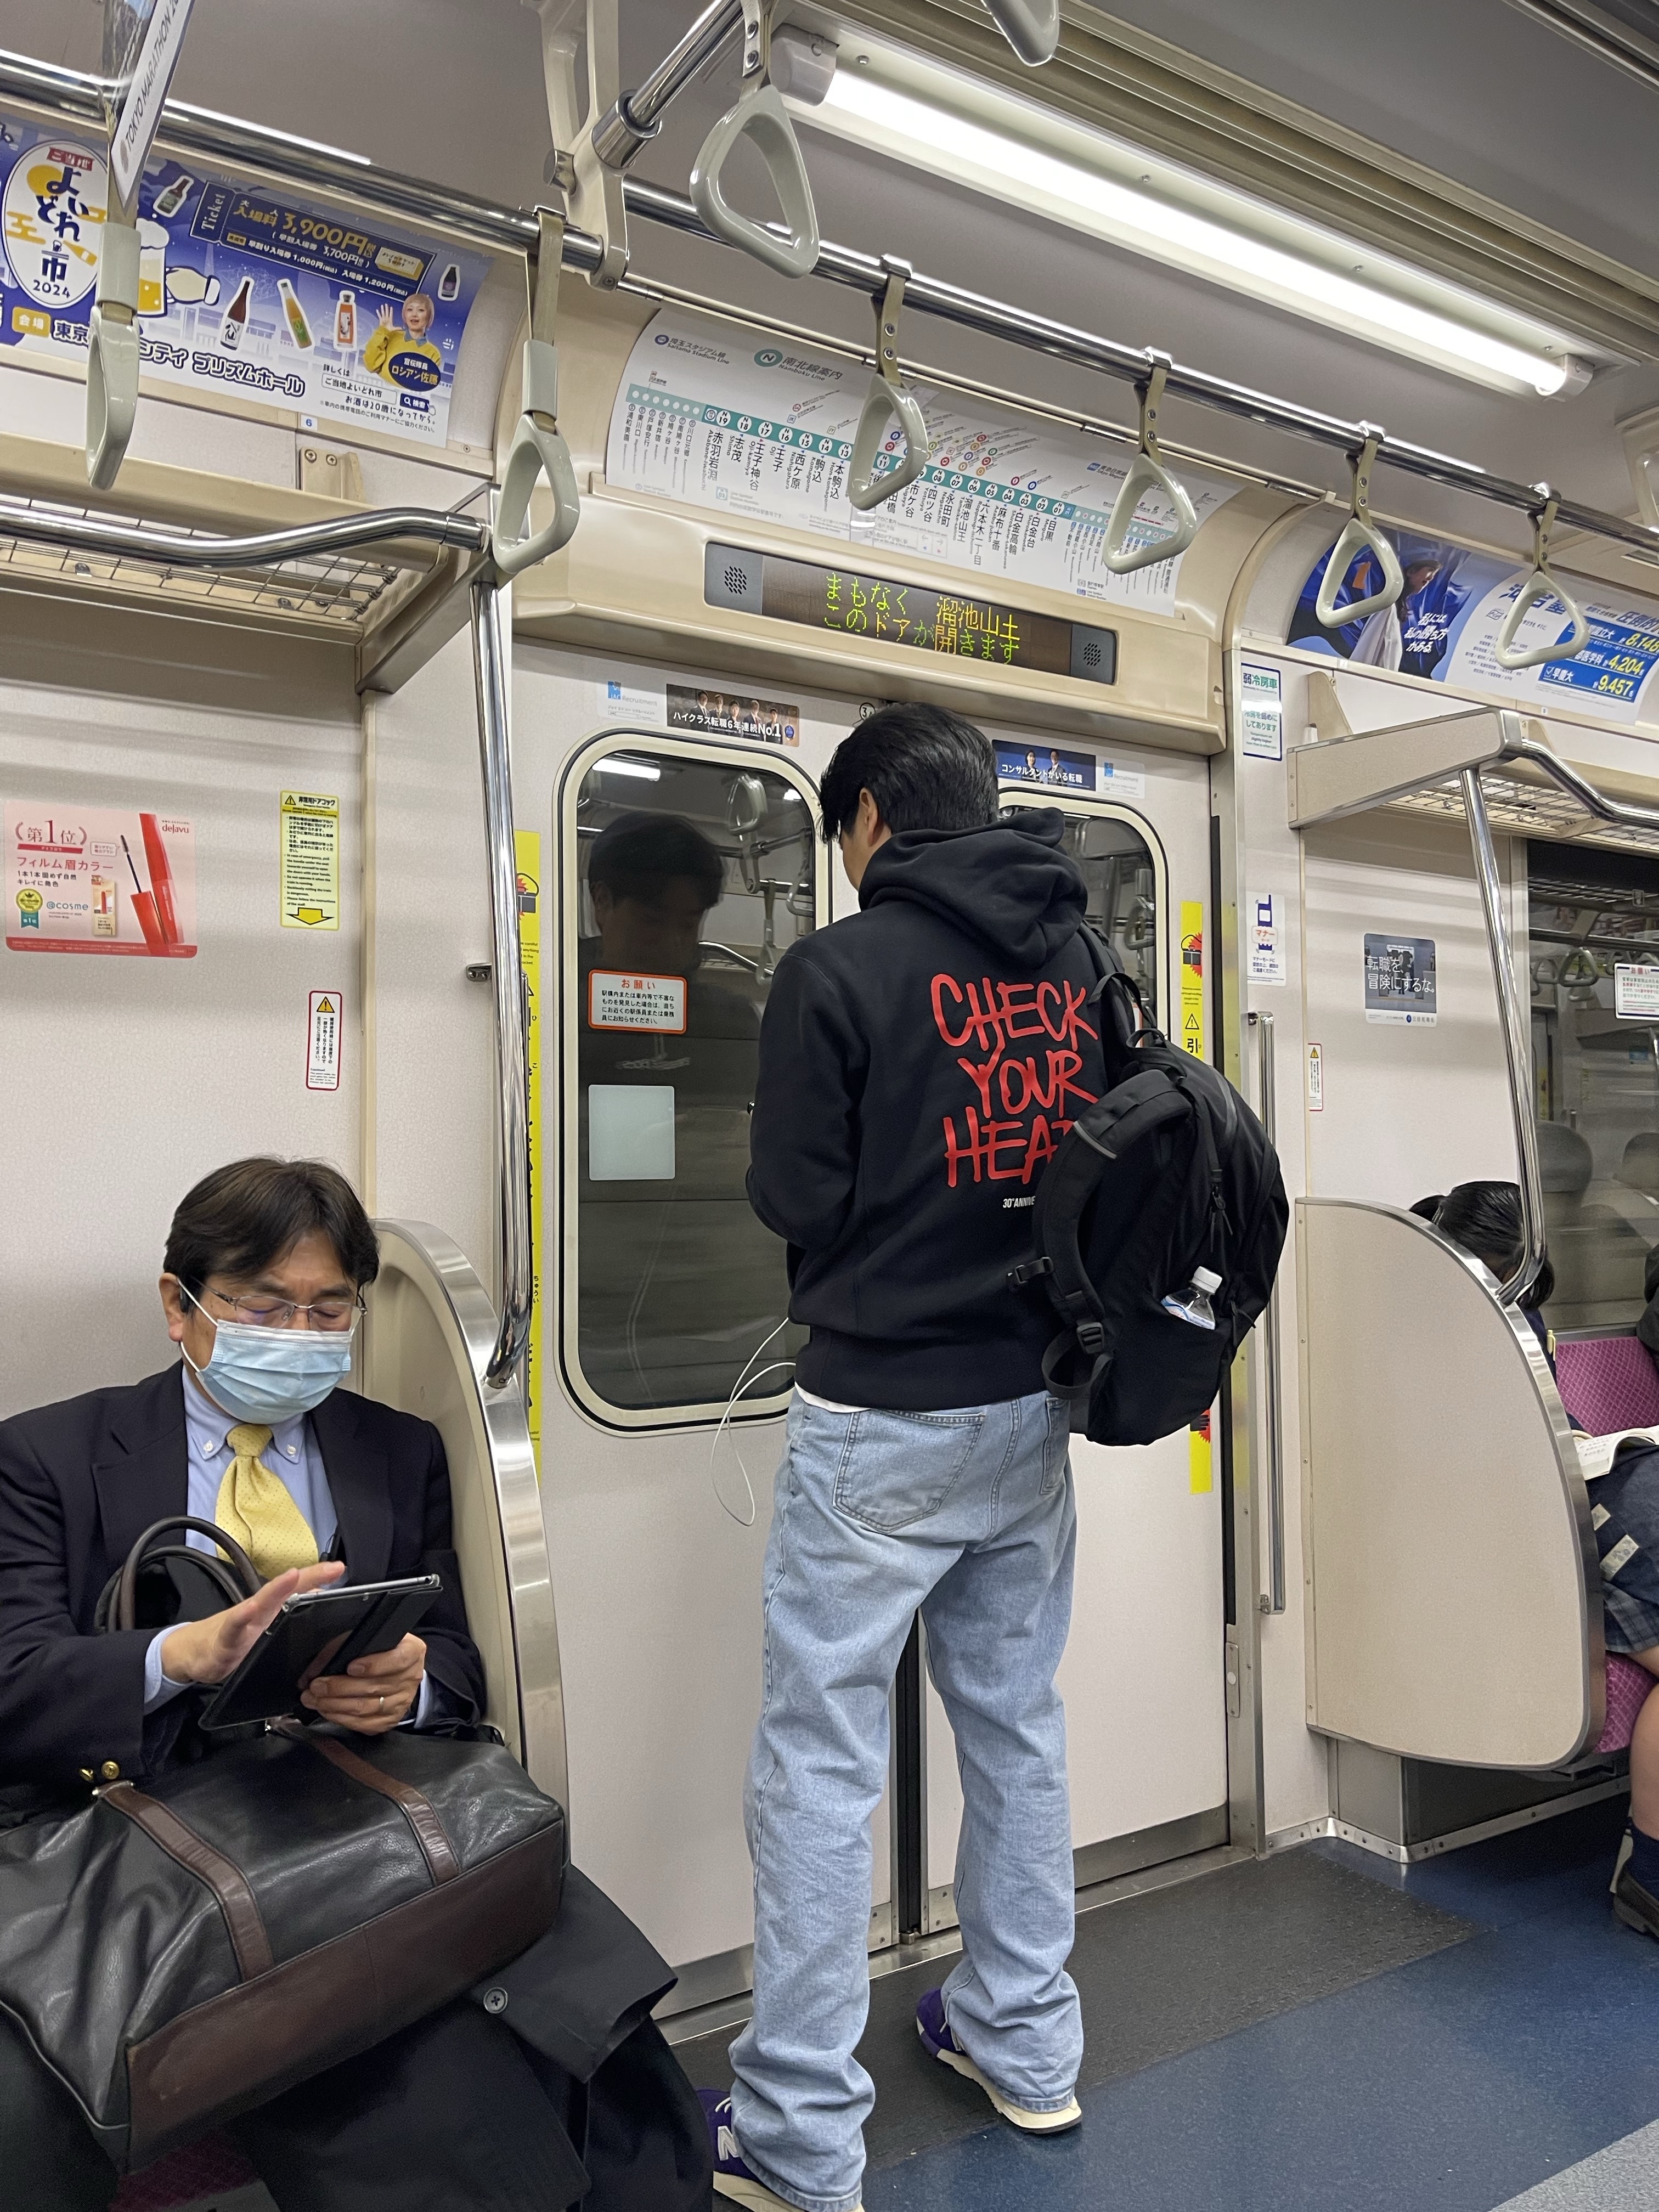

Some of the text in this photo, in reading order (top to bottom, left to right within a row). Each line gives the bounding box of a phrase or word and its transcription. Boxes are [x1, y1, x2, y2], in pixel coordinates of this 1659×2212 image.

[125, 9, 171, 151] TOKYO MARATHON
[201, 194, 225, 230] Ticket
[283, 212, 369, 255] 3,900円
[33, 279, 71, 298] 2024
[667, 343, 691, 353] Saitama
[193, 355, 305, 396] プリズムホール
[323, 364, 350, 377] 詳しくは
[778, 364, 826, 381] Namboku Line
[782, 357, 843, 380] 南北線案内
[305, 418, 313, 427] 6
[719, 416, 728, 425] 19
[740, 422, 749, 430] 18
[731, 438, 745, 462] 志茂
[773, 448, 786, 472] 王子
[750, 442, 766, 491] 王子神谷
[812, 459, 825, 483] 駒込
[830, 465, 845, 499] 本駒込
[941, 493, 955, 527] 永田町
[957, 498, 973, 543] 溜池山王
[974, 503, 990, 566] 六本木一丁目
[992, 507, 1008, 551] 麻布十番
[1027, 516, 1040, 548] 白金台
[1045, 520, 1057, 542] 目黒
[826, 572, 908, 615] まもなく
[823, 603, 1020, 665] このドアが開きます
[1609, 654, 1644, 675] 4,204
[1243, 673, 1278, 689] 弱冷房車
[1598, 675, 1633, 696] 9,457
[622, 695, 657, 706] Recruitment
[1246, 720, 1277, 732] してあります
[1001, 764, 1082, 783] コンサルタントがいる転職
[17, 856, 113, 871] フィルム眉カラー
[46, 901, 89, 911] @cosme
[1255, 929, 1276, 938] マナー
[1367, 955, 1404, 973] 転職を、
[621, 979, 656, 990] お願い
[1368, 973, 1435, 993] 冒険にするな。
[930, 973, 1098, 1052] CHECK
[957, 1049, 1099, 1119] YOUR
